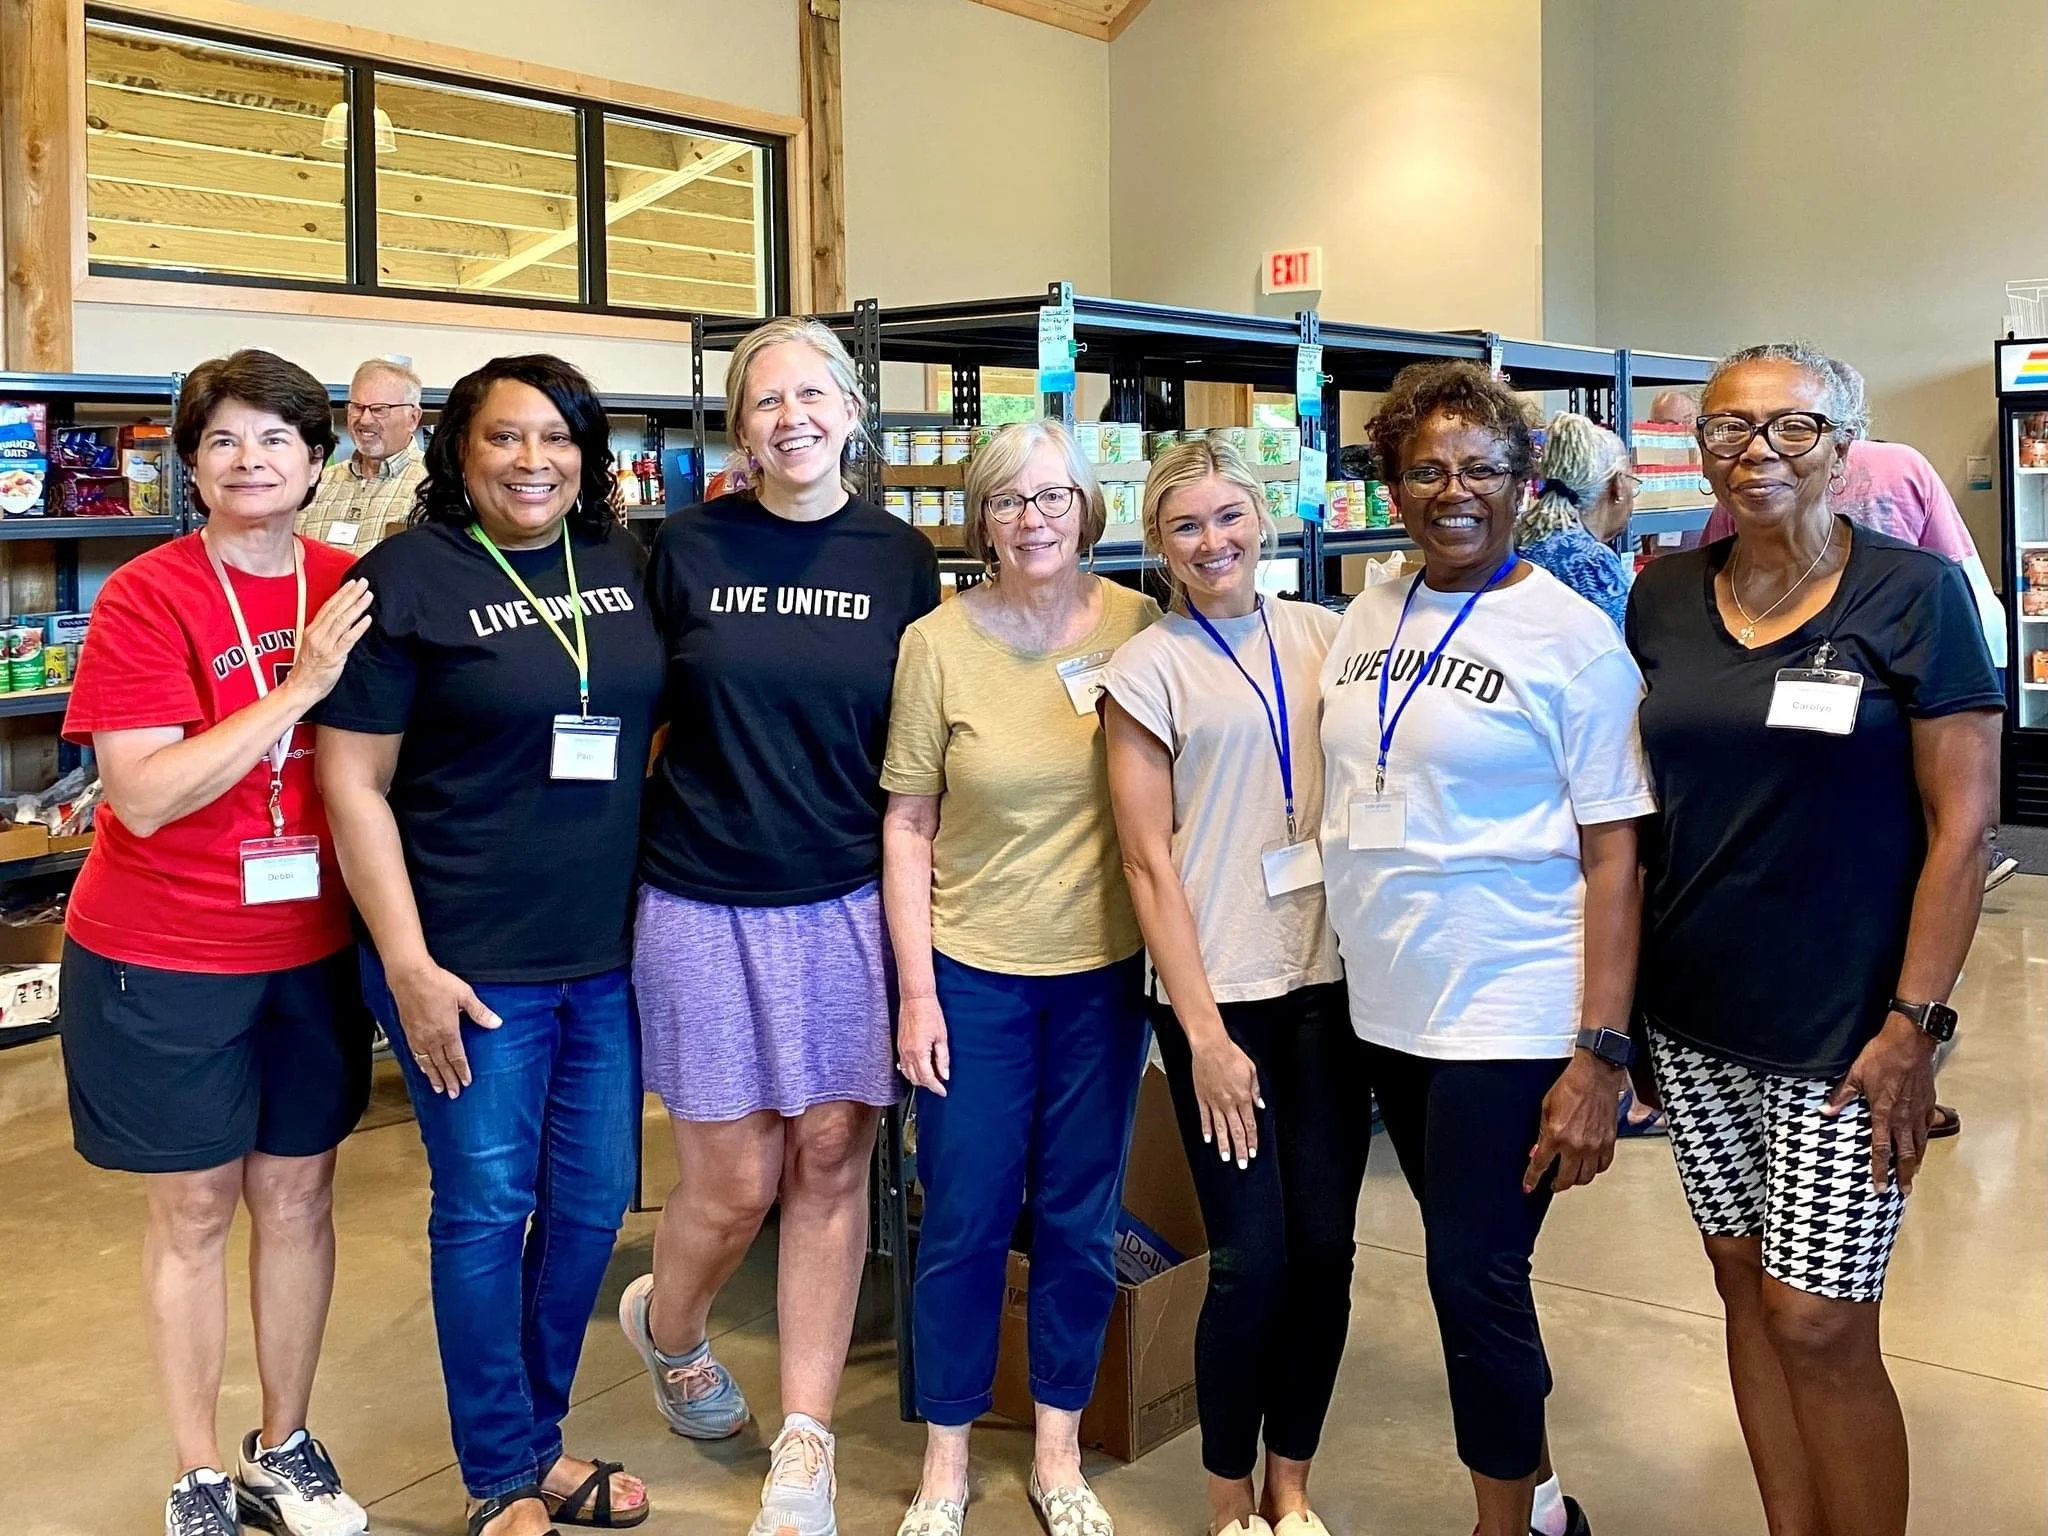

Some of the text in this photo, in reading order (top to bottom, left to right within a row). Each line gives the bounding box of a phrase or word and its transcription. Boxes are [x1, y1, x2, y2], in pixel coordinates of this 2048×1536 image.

[1272, 252, 1310, 286] EXIT
[4, 448, 28, 458] OATS
[469, 586, 634, 637] LIVE UNITED
[710, 586, 871, 620] LIVE UNITED
[213, 627, 297, 679] VOUN
[1336, 648, 1504, 704] LIVE UNITED
[1792, 700, 1832, 713] Carolyn
[267, 871, 294, 882] Debbi
